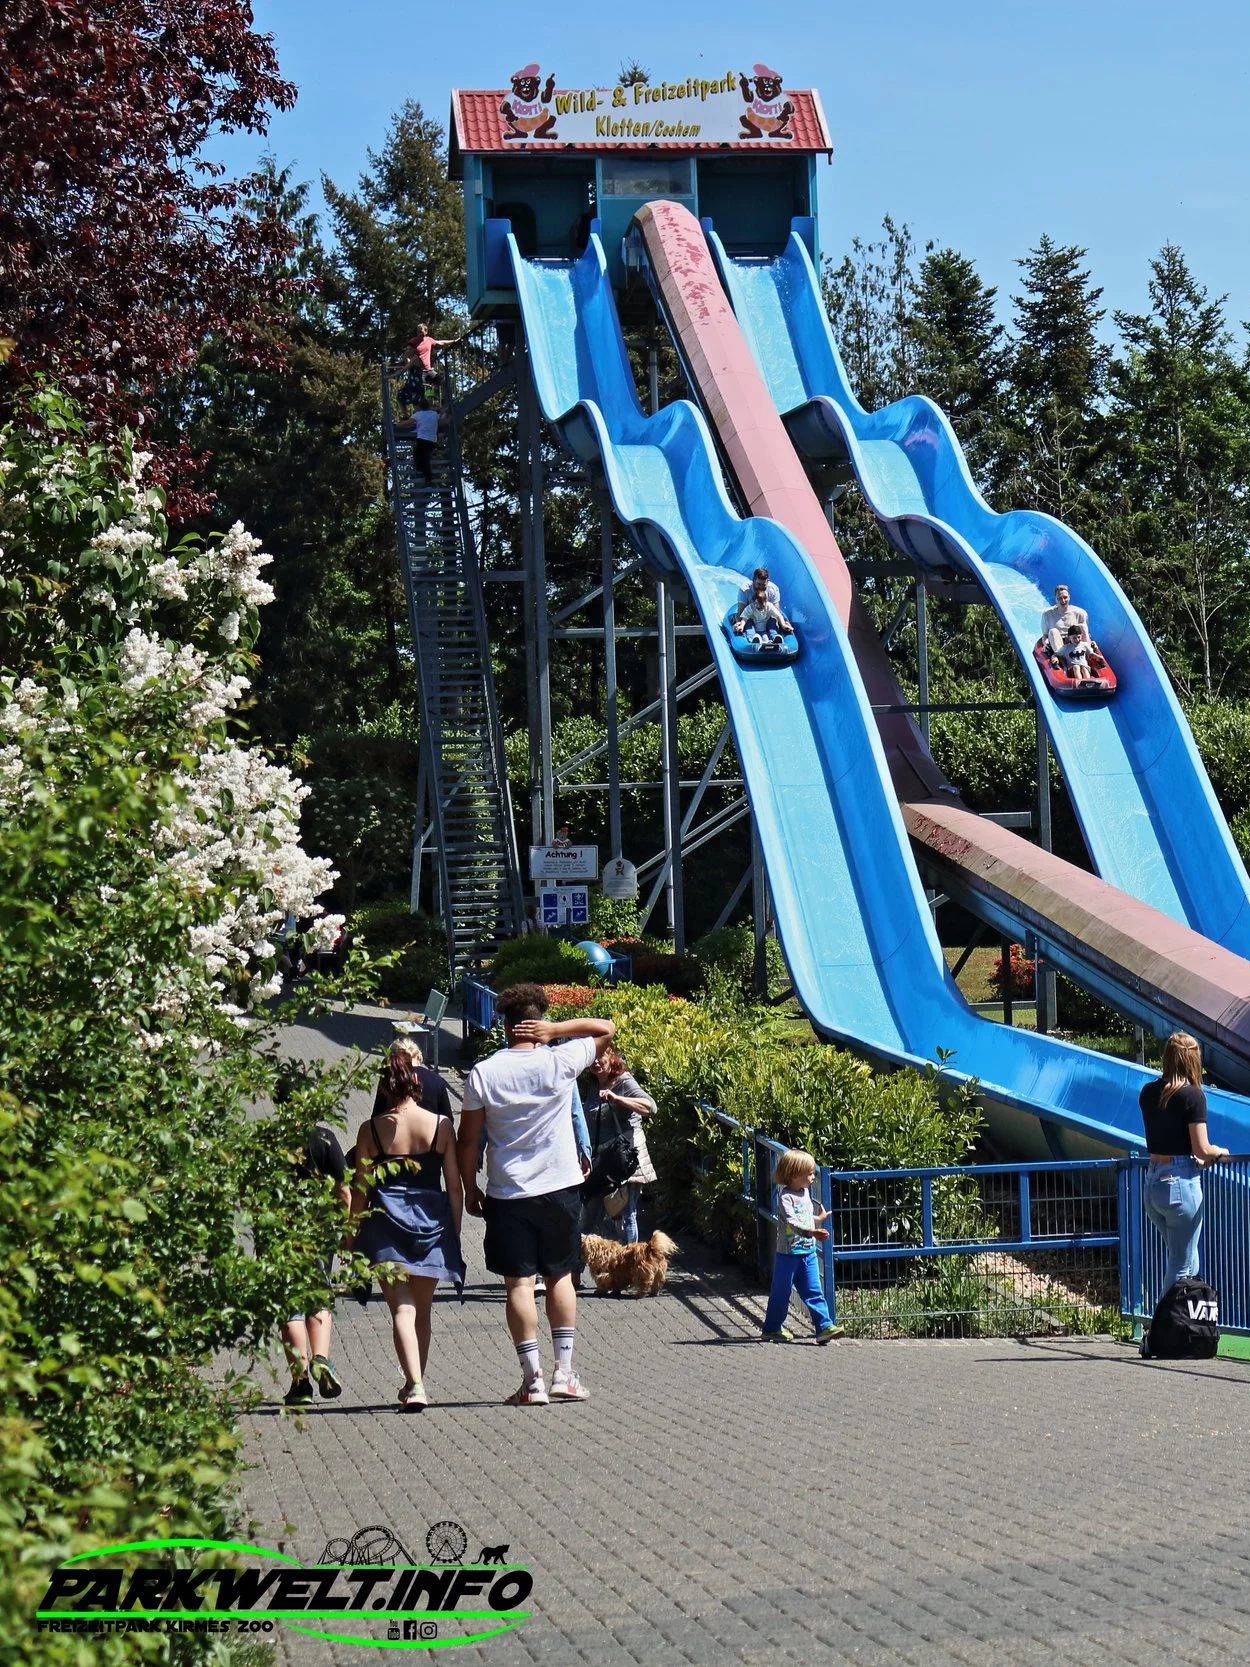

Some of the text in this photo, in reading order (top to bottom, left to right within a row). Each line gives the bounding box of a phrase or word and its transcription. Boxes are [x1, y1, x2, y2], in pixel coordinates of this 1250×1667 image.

[556, 70, 737, 115] Wild- & Freizeitpark
[595, 115, 702, 138] Klotten/Cochem
[545, 850, 578, 859] Achtung
[1187, 1300, 1218, 1322] VAN
